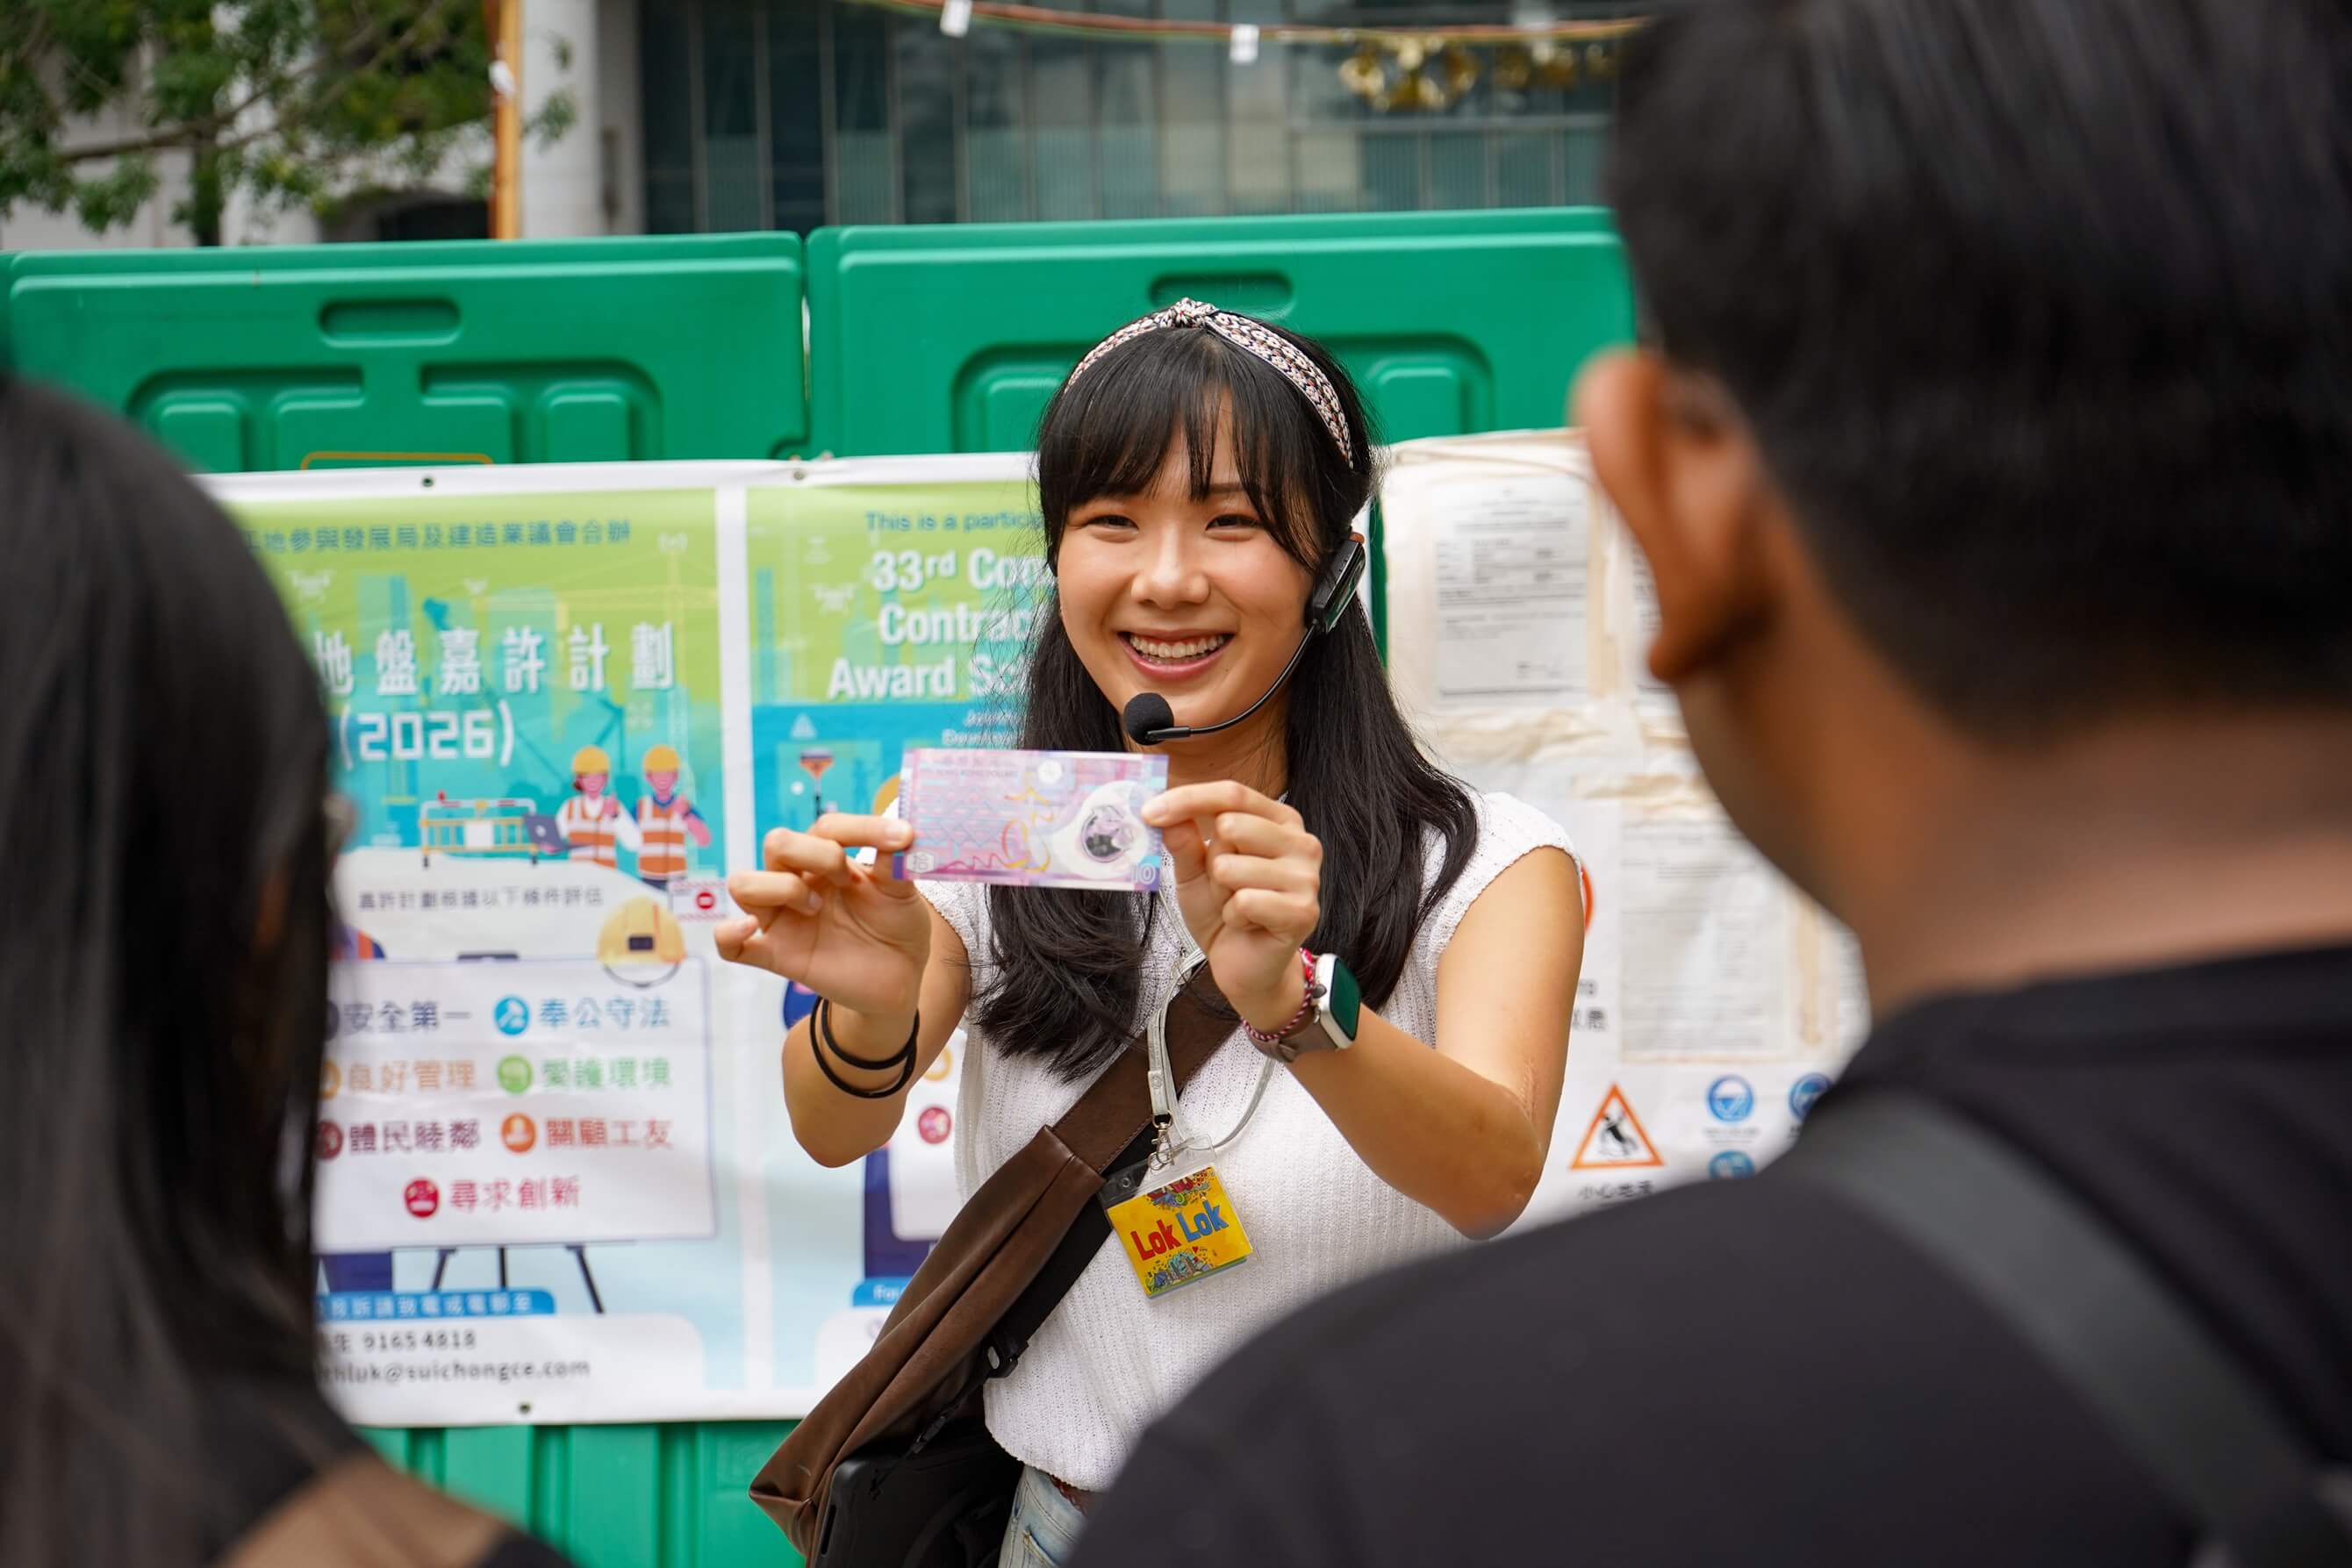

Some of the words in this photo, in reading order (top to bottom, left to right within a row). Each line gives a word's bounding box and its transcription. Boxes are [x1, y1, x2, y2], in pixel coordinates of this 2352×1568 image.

[865, 512, 911, 532] This
[917, 512, 937, 531] is
[942, 515, 957, 530] a
[871, 548, 957, 592] 33rd
[879, 603, 1043, 646] Contrac
[312, 620, 676, 696] 地盤嘉許計劃
[827, 658, 957, 699] Award
[338, 699, 515, 770] (2026)
[342, 999, 471, 1034] 安全第一
[539, 995, 672, 1028] 奉公守法
[348, 1059, 477, 1092] 良好管理
[541, 1056, 673, 1090] 愛護環境
[544, 1118, 675, 1151] 關顧工友
[448, 1175, 582, 1212] 尋求創新
[1130, 1220, 1182, 1261] Lok
[1174, 1192, 1230, 1243] Lok
[319, 1357, 590, 1385] hluk@suichongce.com
